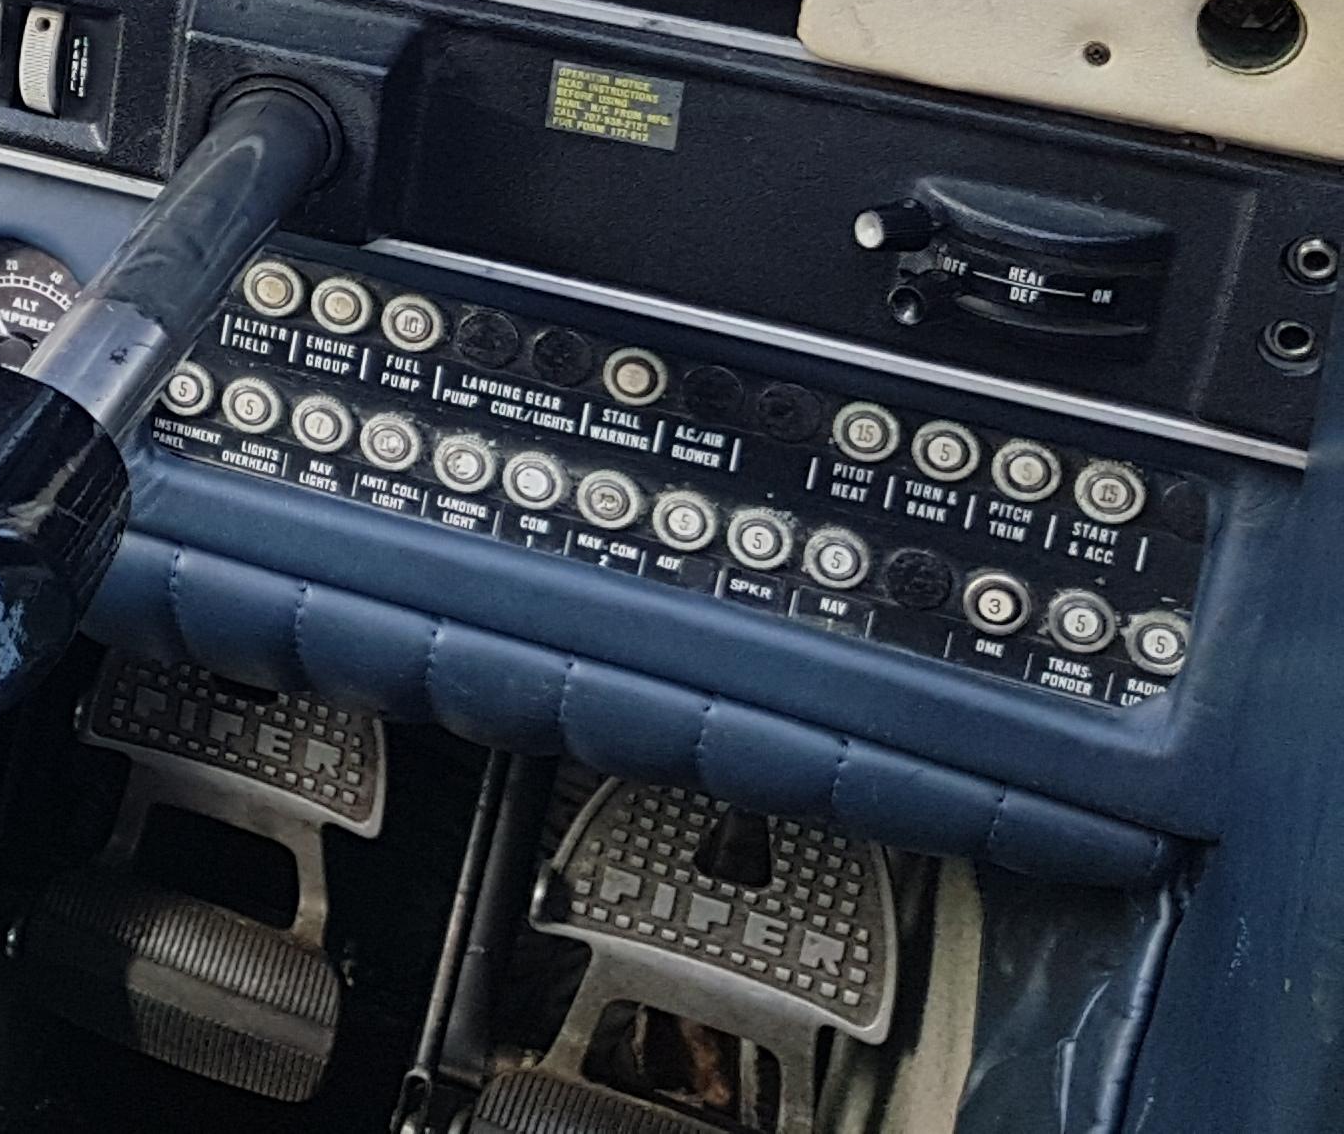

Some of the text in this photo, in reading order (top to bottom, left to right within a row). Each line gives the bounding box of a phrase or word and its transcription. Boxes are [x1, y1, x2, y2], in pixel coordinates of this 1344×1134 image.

[12, 297, 39, 312] ALT
[233, 317, 287, 341] ALTNTR
[232, 334, 270, 355] FIELD
[306, 335, 357, 359] ENGINE
[305, 353, 351, 375] GROUP
[386, 354, 421, 375] FUEL
[179, 381, 188, 398] 5
[381, 372, 421, 393] PUMP
[462, 374, 562, 411] LANDING GEAR
[442, 388, 479, 409] PUMP
[602, 409, 641, 429] STALL
[153, 431, 185, 450] PANEL
[154, 417, 222, 445] INSTRUMENT
[589, 424, 649, 451] WARNING
[241, 440, 280, 461] LIGHTS
[671, 444, 721, 468] BLOWER
[221, 451, 277, 475] OVERHEAD
[309, 460, 333, 476] NAV
[833, 463, 874, 484] PITOT
[298, 471, 338, 495] LIGHTS
[360, 474, 420, 501] ANTI COLL
[831, 482, 868, 503] HEAT
[904, 480, 943, 502] TURN
[371, 491, 404, 511] LIGHT
[436, 494, 487, 518] LANDING
[906, 501, 947, 522] BANK
[442, 511, 476, 531] LIGHT
[988, 501, 1033, 523] PITCH
[519, 515, 549, 534] COM
[988, 520, 1026, 543] TRIM
[1072, 521, 1119, 546] START
[752, 532, 763, 550] 5
[729, 578, 772, 600] SPKR
[819, 597, 847, 616] NAV
[988, 598, 1001, 615] 3
[1075, 614, 1087, 633] 5
[975, 639, 1005, 658] DME
[1047, 657, 1092, 678] TRANS-
[1040, 672, 1094, 696] PONDER
[600, 864, 848, 978] PIPER
